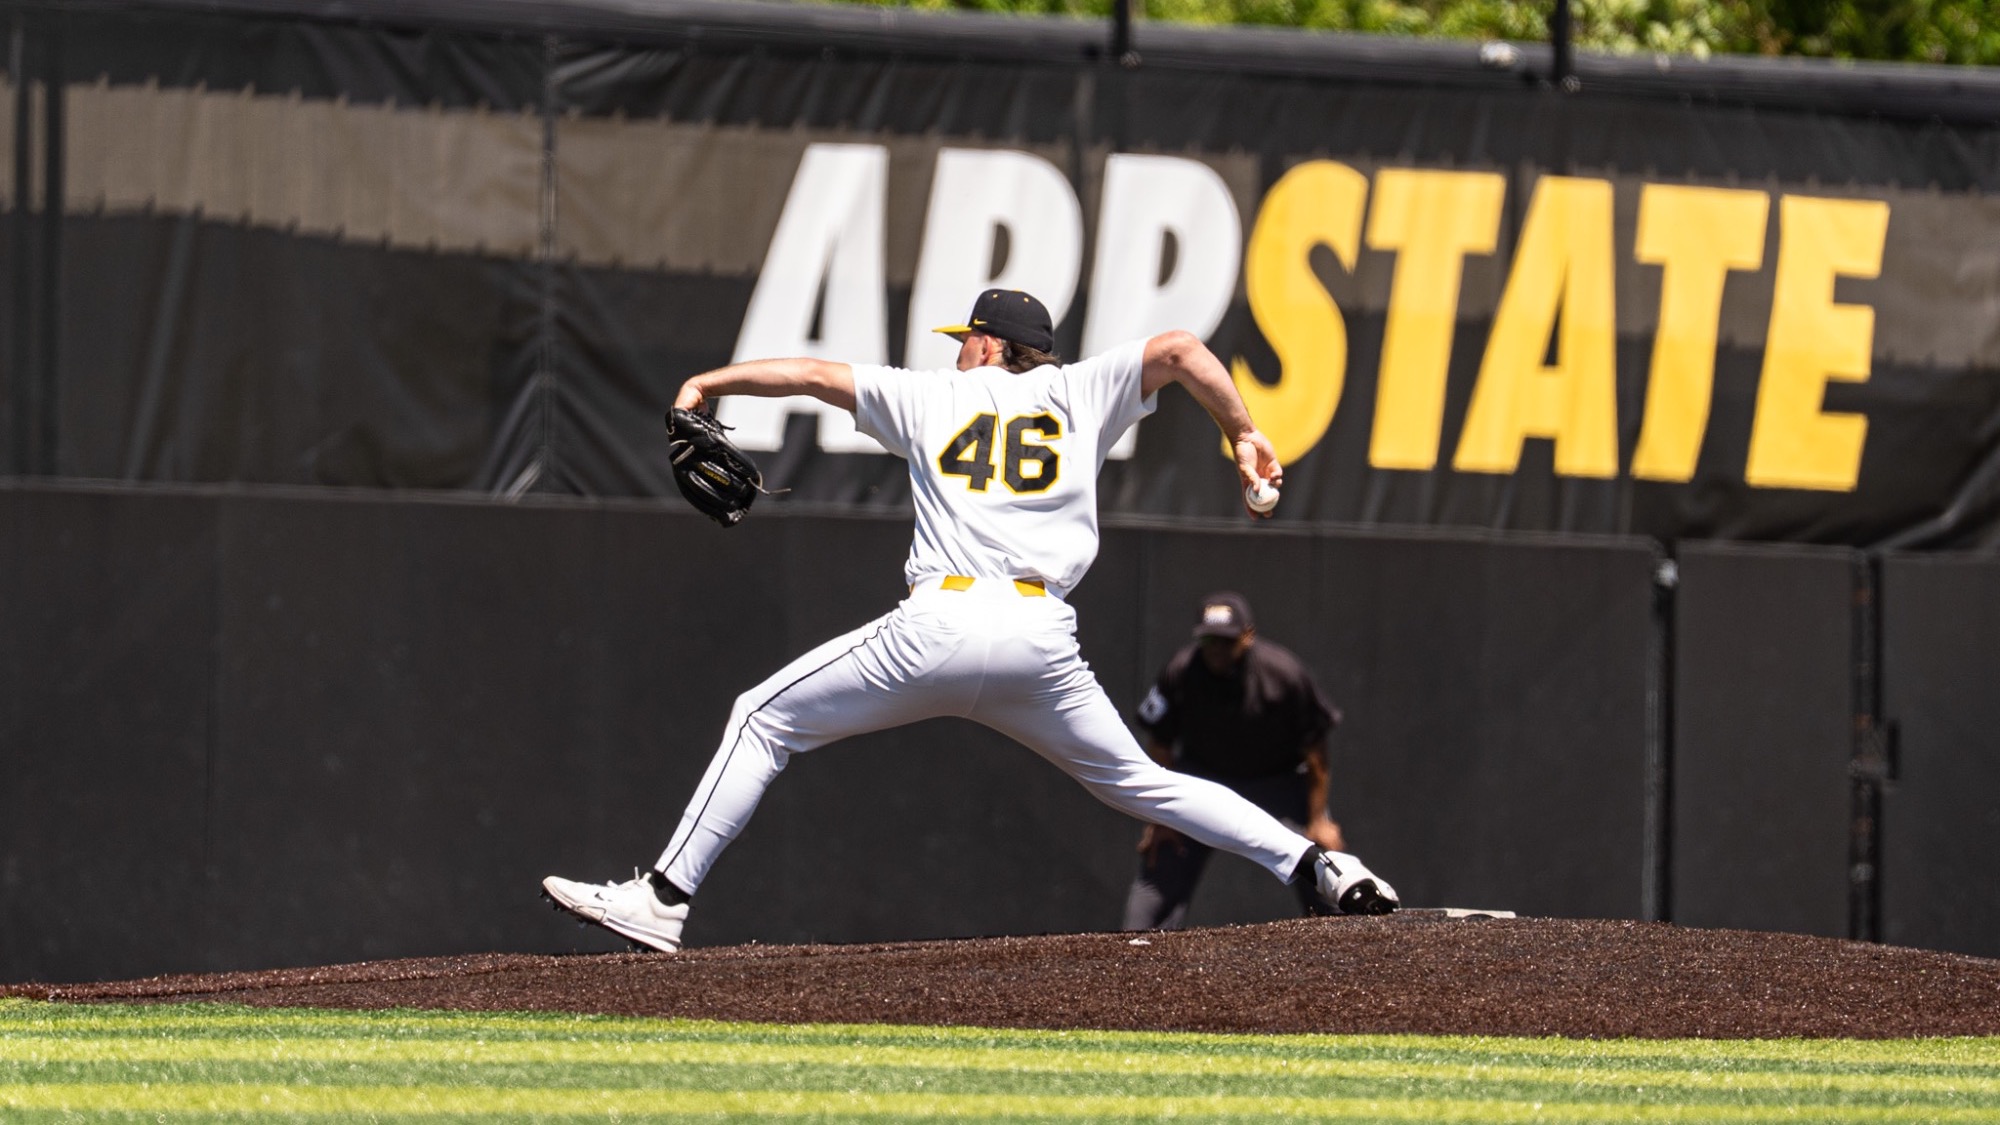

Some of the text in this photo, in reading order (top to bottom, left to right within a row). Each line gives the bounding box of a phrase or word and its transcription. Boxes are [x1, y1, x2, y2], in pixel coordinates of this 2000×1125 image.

[715, 143, 1890, 491] APP STATE
[938, 411, 1062, 495] 46
